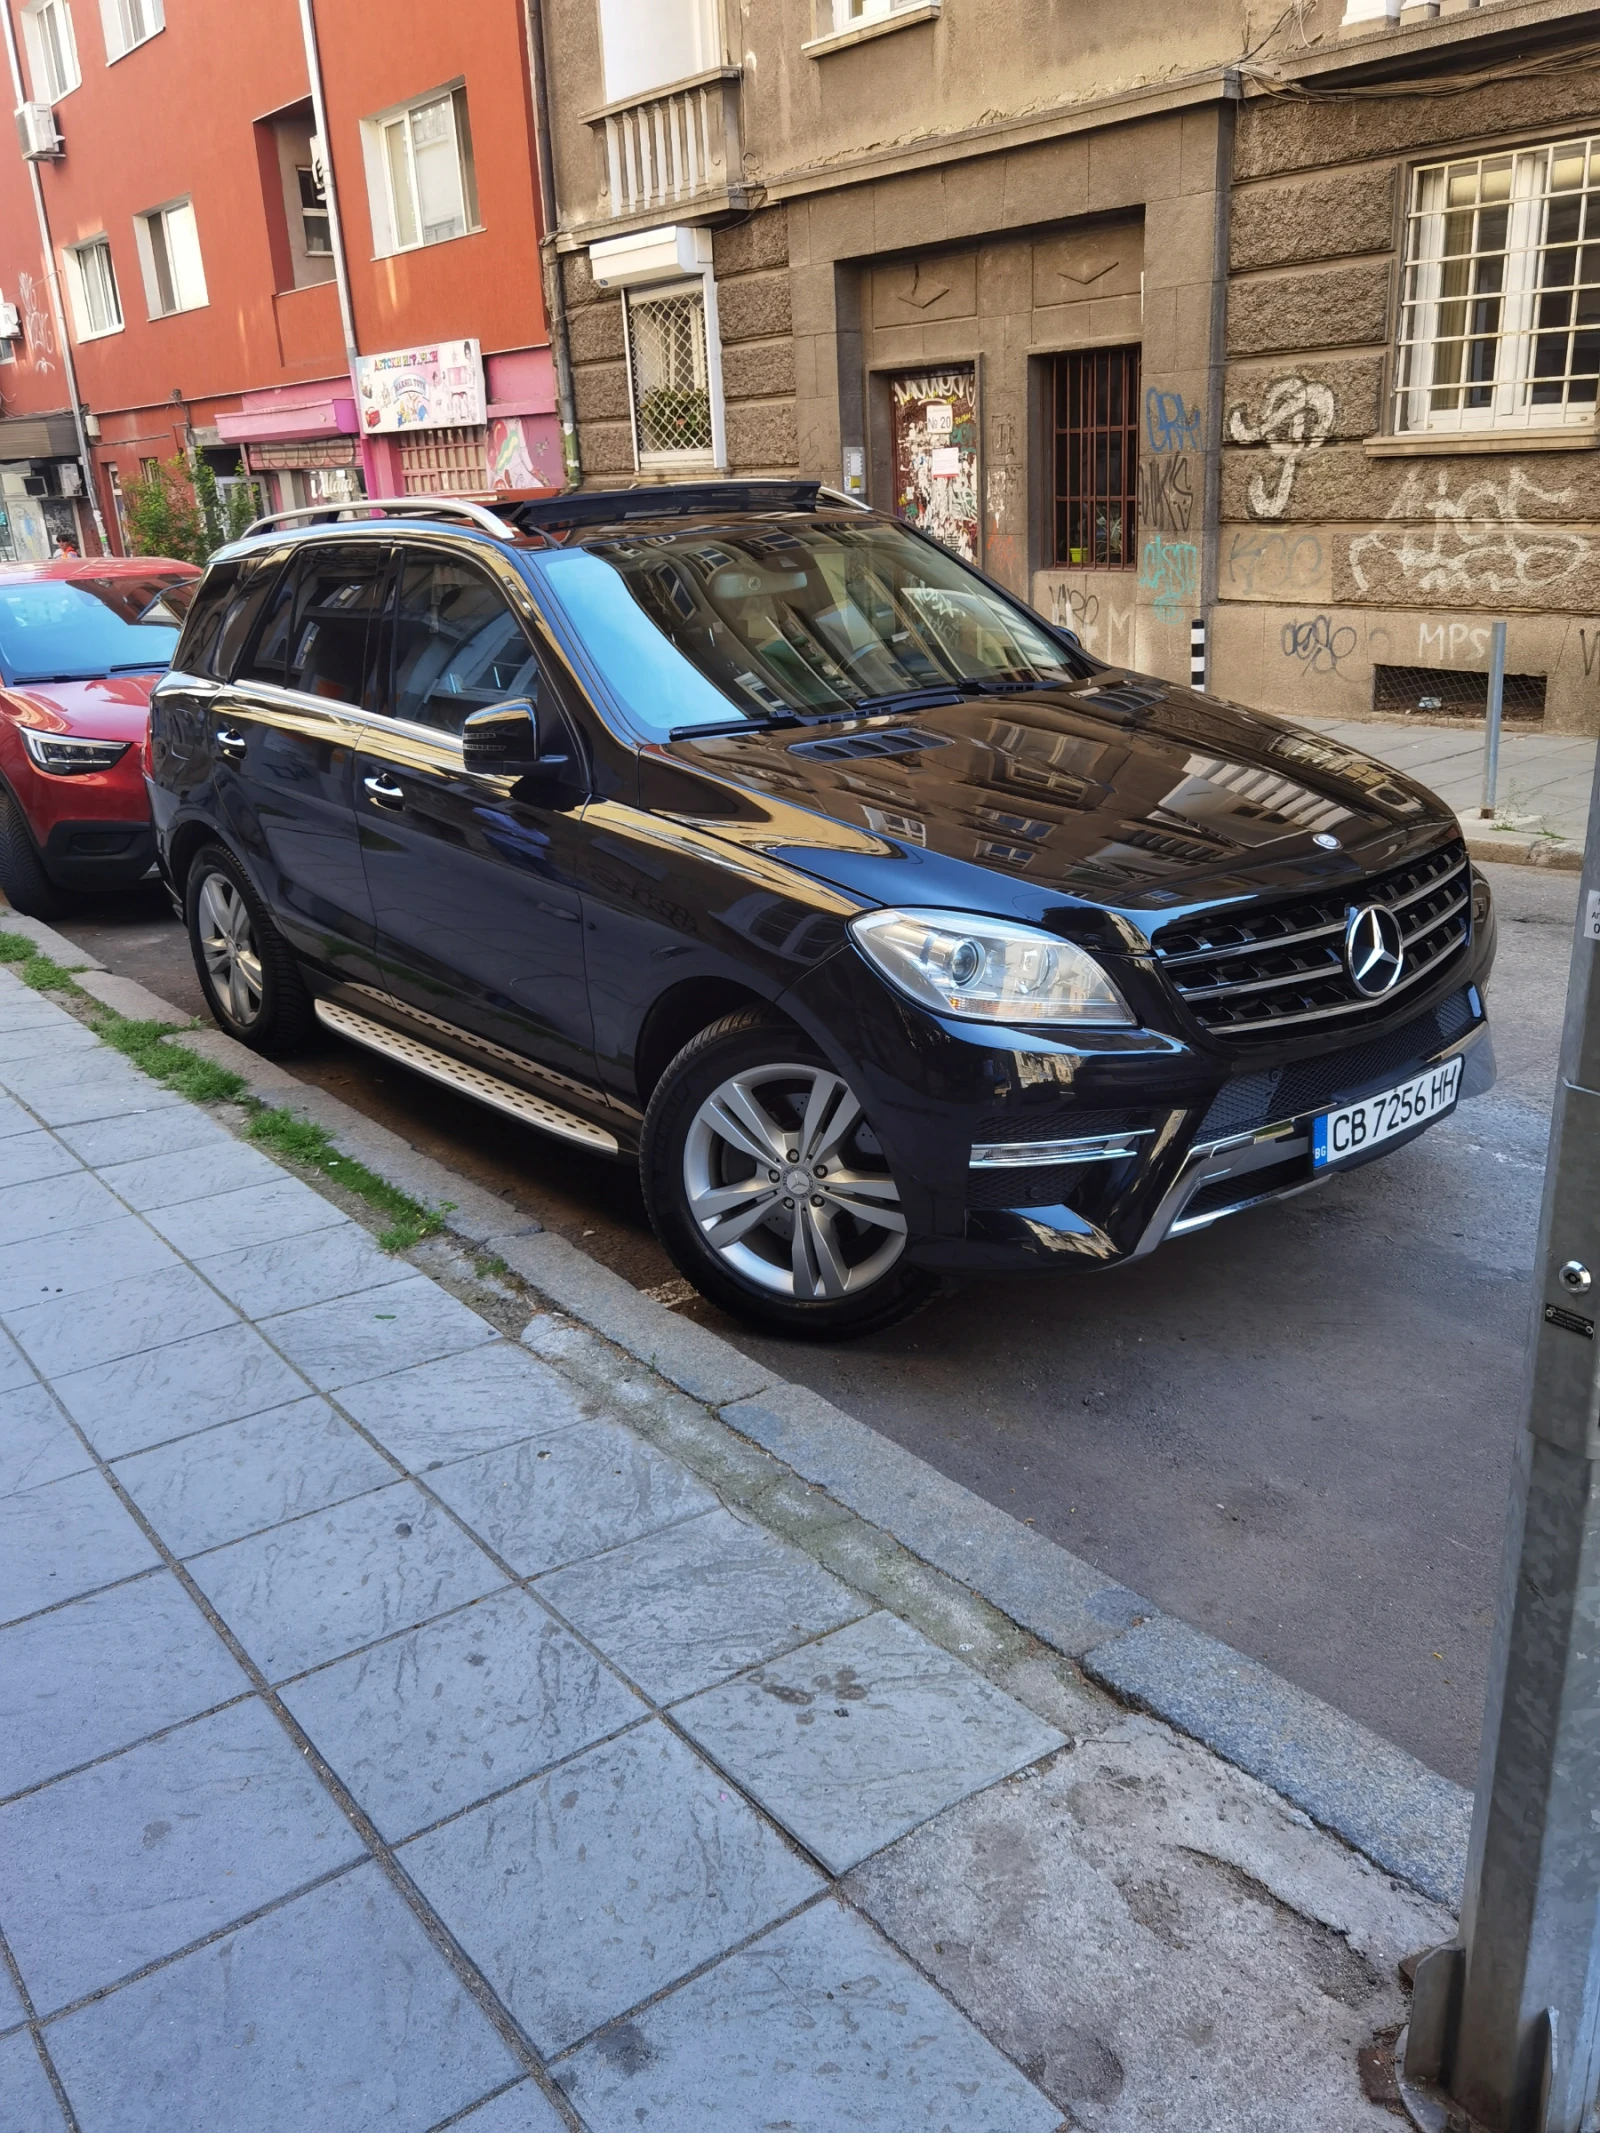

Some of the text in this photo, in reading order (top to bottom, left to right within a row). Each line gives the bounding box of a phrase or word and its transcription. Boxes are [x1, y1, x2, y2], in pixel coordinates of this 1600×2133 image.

[940, 416, 952, 429] 20
[1418, 622, 1491, 661] MPS
[1372, 1081, 1427, 1138] 7256
[1314, 1145, 1327, 1160] BG
